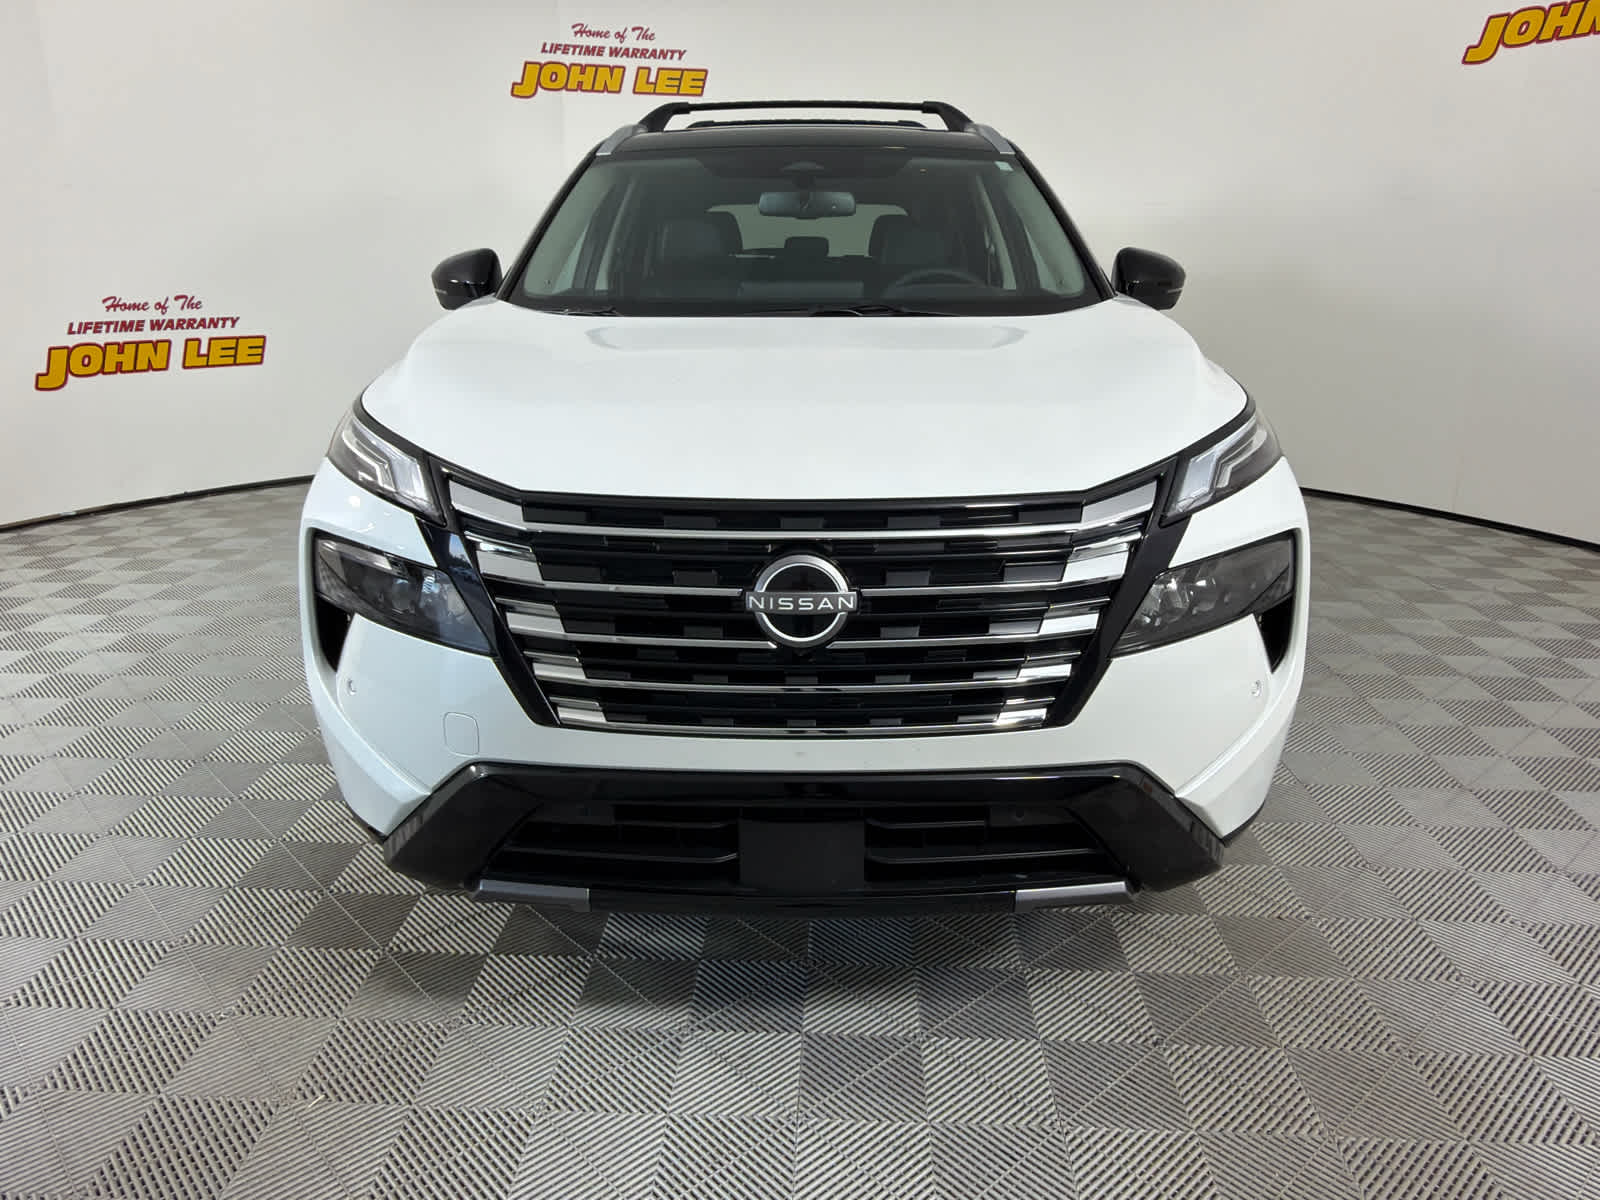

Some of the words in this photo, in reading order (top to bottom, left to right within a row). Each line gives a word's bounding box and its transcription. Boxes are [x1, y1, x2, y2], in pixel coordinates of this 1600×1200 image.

[571, 23, 610, 39] Home
[614, 27, 628, 44] of
[631, 26, 656, 41] The
[541, 42, 605, 57] LIFETIME
[608, 46, 687, 61] WARRANTY
[511, 60, 626, 99] JOHN
[632, 66, 708, 97] LEE
[102, 296, 150, 312] Home
[154, 297, 169, 314] of
[173, 295, 202, 310] The
[67, 320, 145, 335] LIFETIME
[150, 316, 240, 331] WARRANTY
[35, 339, 172, 392] JOHN
[182, 335, 266, 370] LEE
[748, 596, 855, 611] NISSAN
